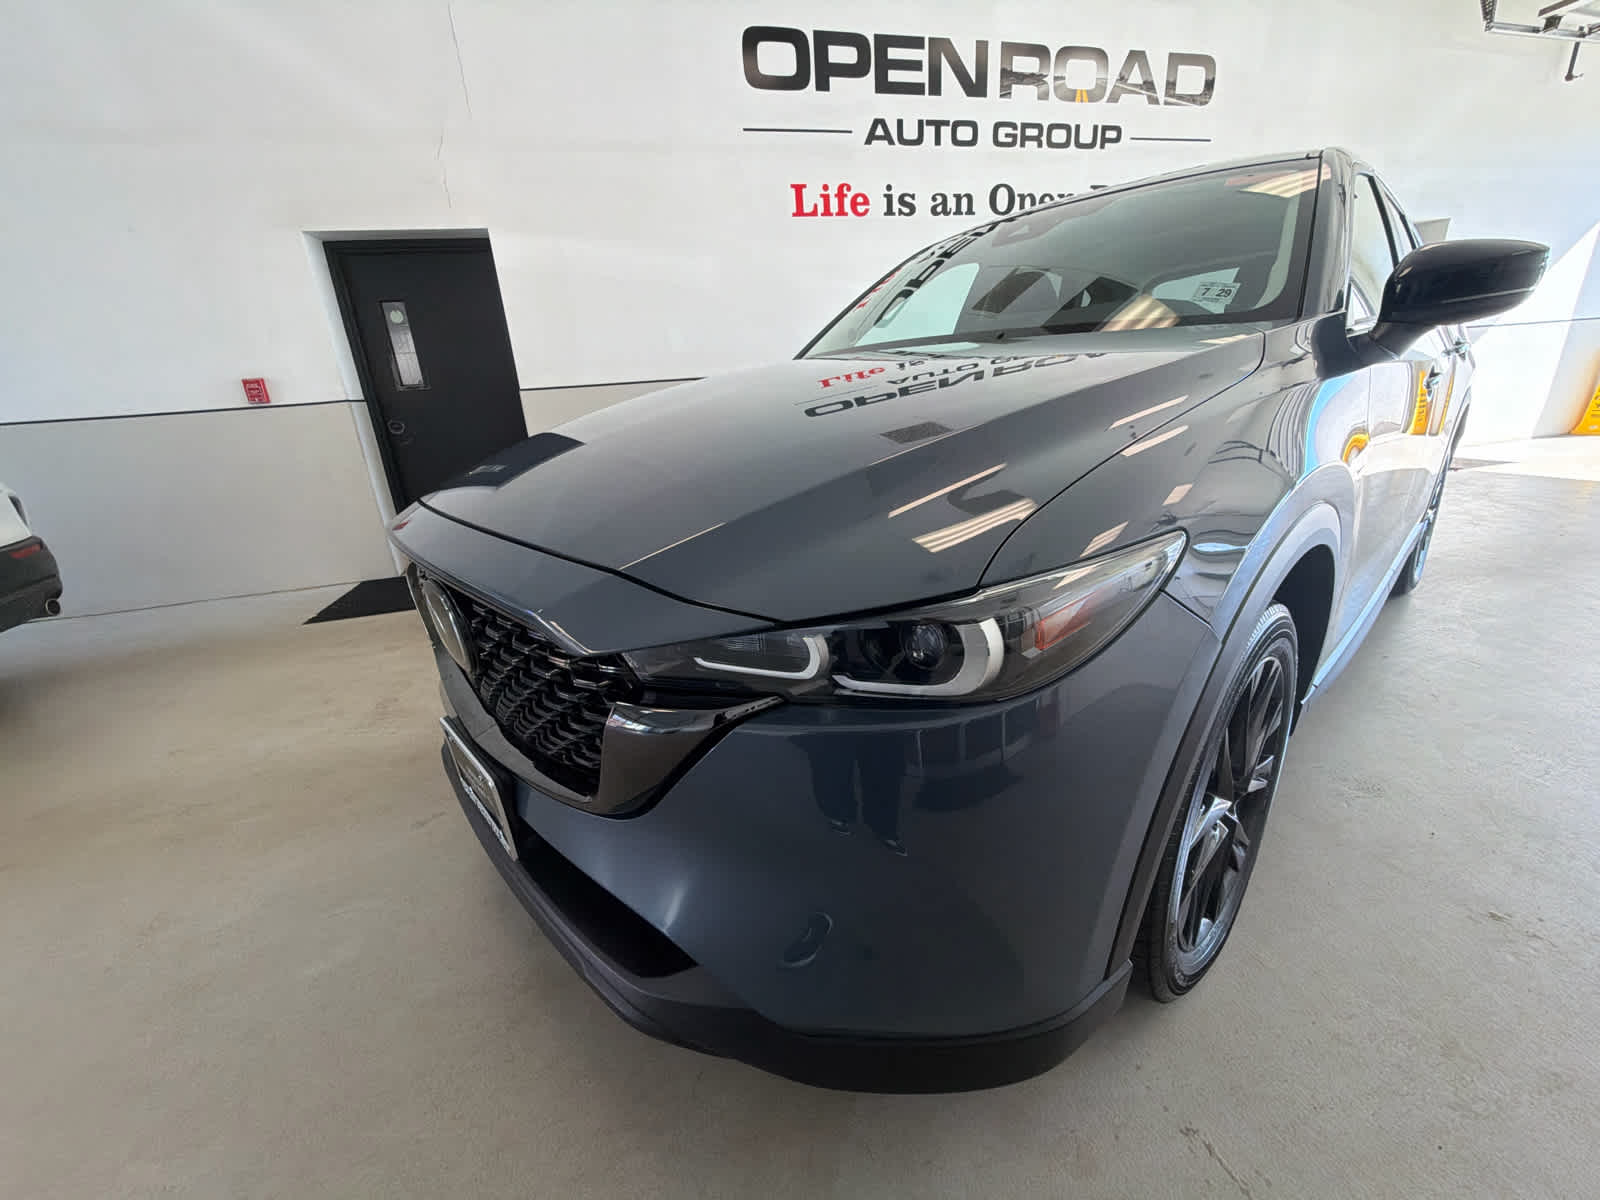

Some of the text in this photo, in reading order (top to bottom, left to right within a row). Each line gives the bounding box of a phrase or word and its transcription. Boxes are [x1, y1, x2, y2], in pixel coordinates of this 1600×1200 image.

[864, 118, 1122, 150] AUTO GROUP
[790, 183, 870, 217] Life
[883, 184, 917, 217] is
[930, 190, 976, 217] an
[1201, 287, 1232, 298] 7 29
